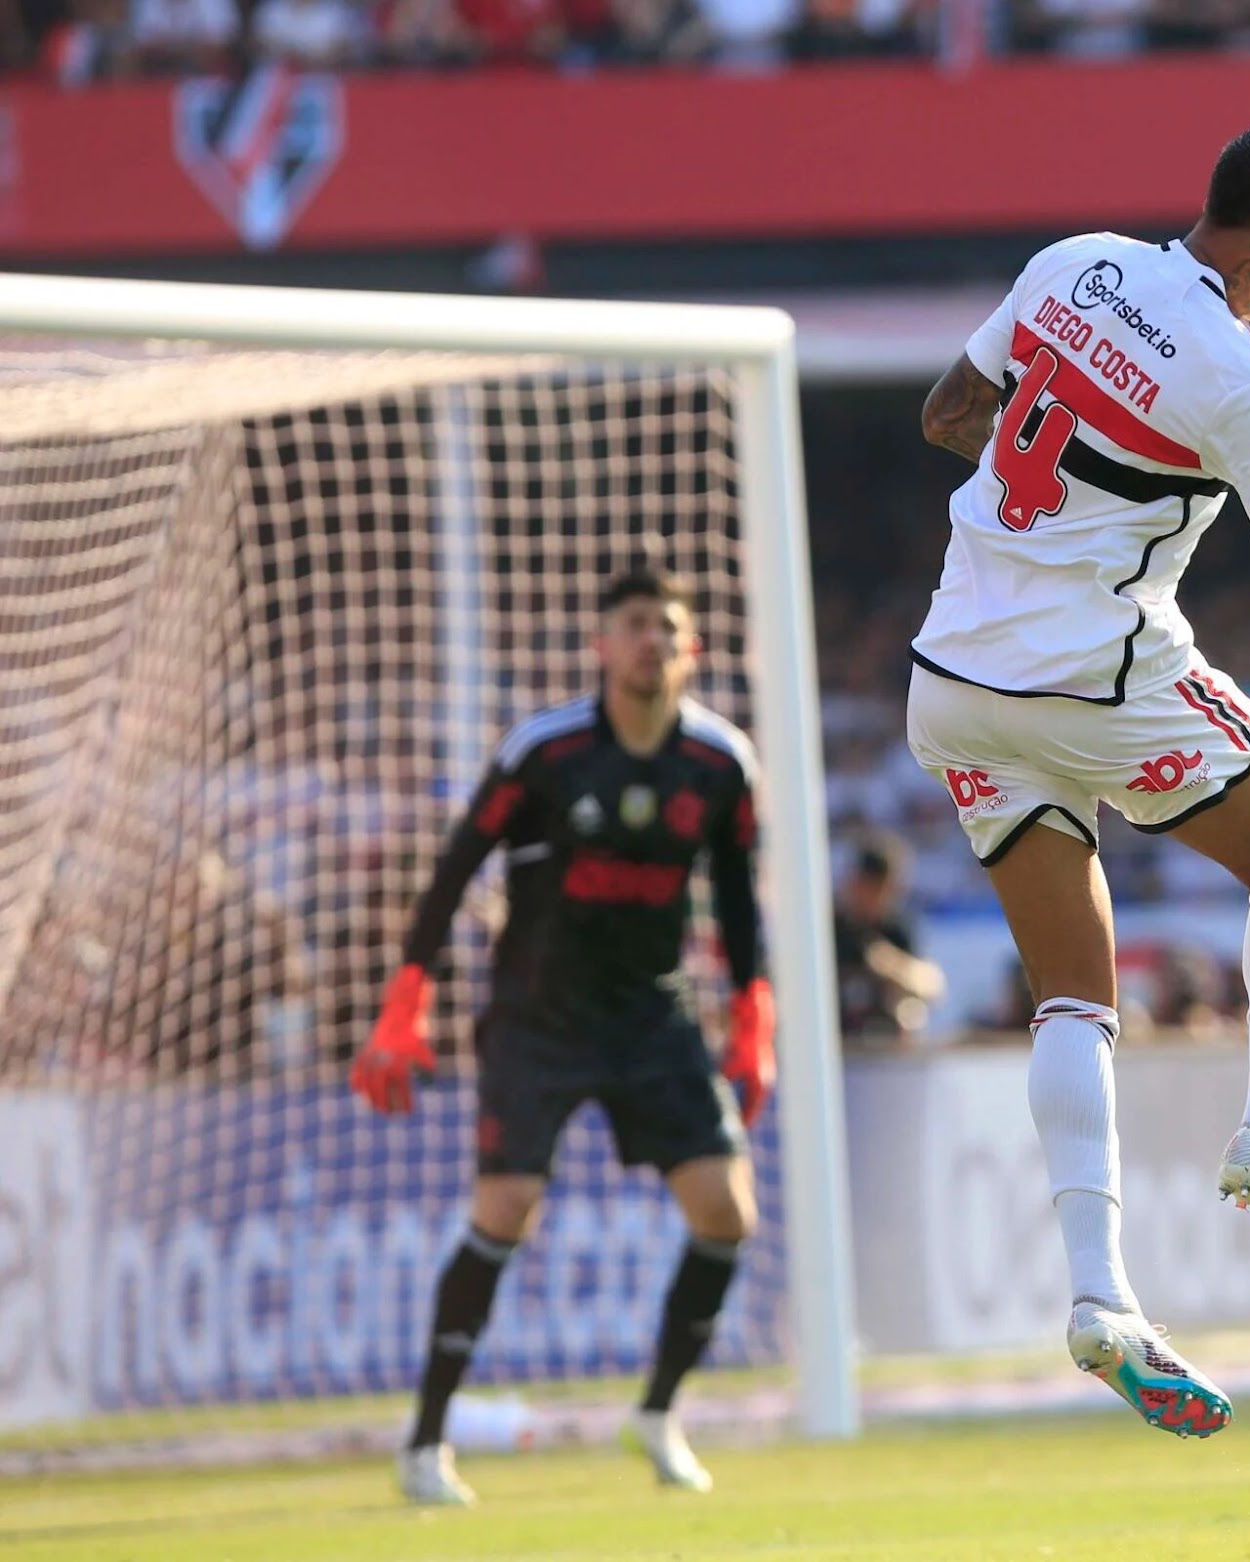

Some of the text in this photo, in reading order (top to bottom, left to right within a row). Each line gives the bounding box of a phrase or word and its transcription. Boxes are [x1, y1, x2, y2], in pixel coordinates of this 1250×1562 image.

[1033, 295, 1161, 414] DIEGO COSTA
[992, 345, 1078, 532] 4
